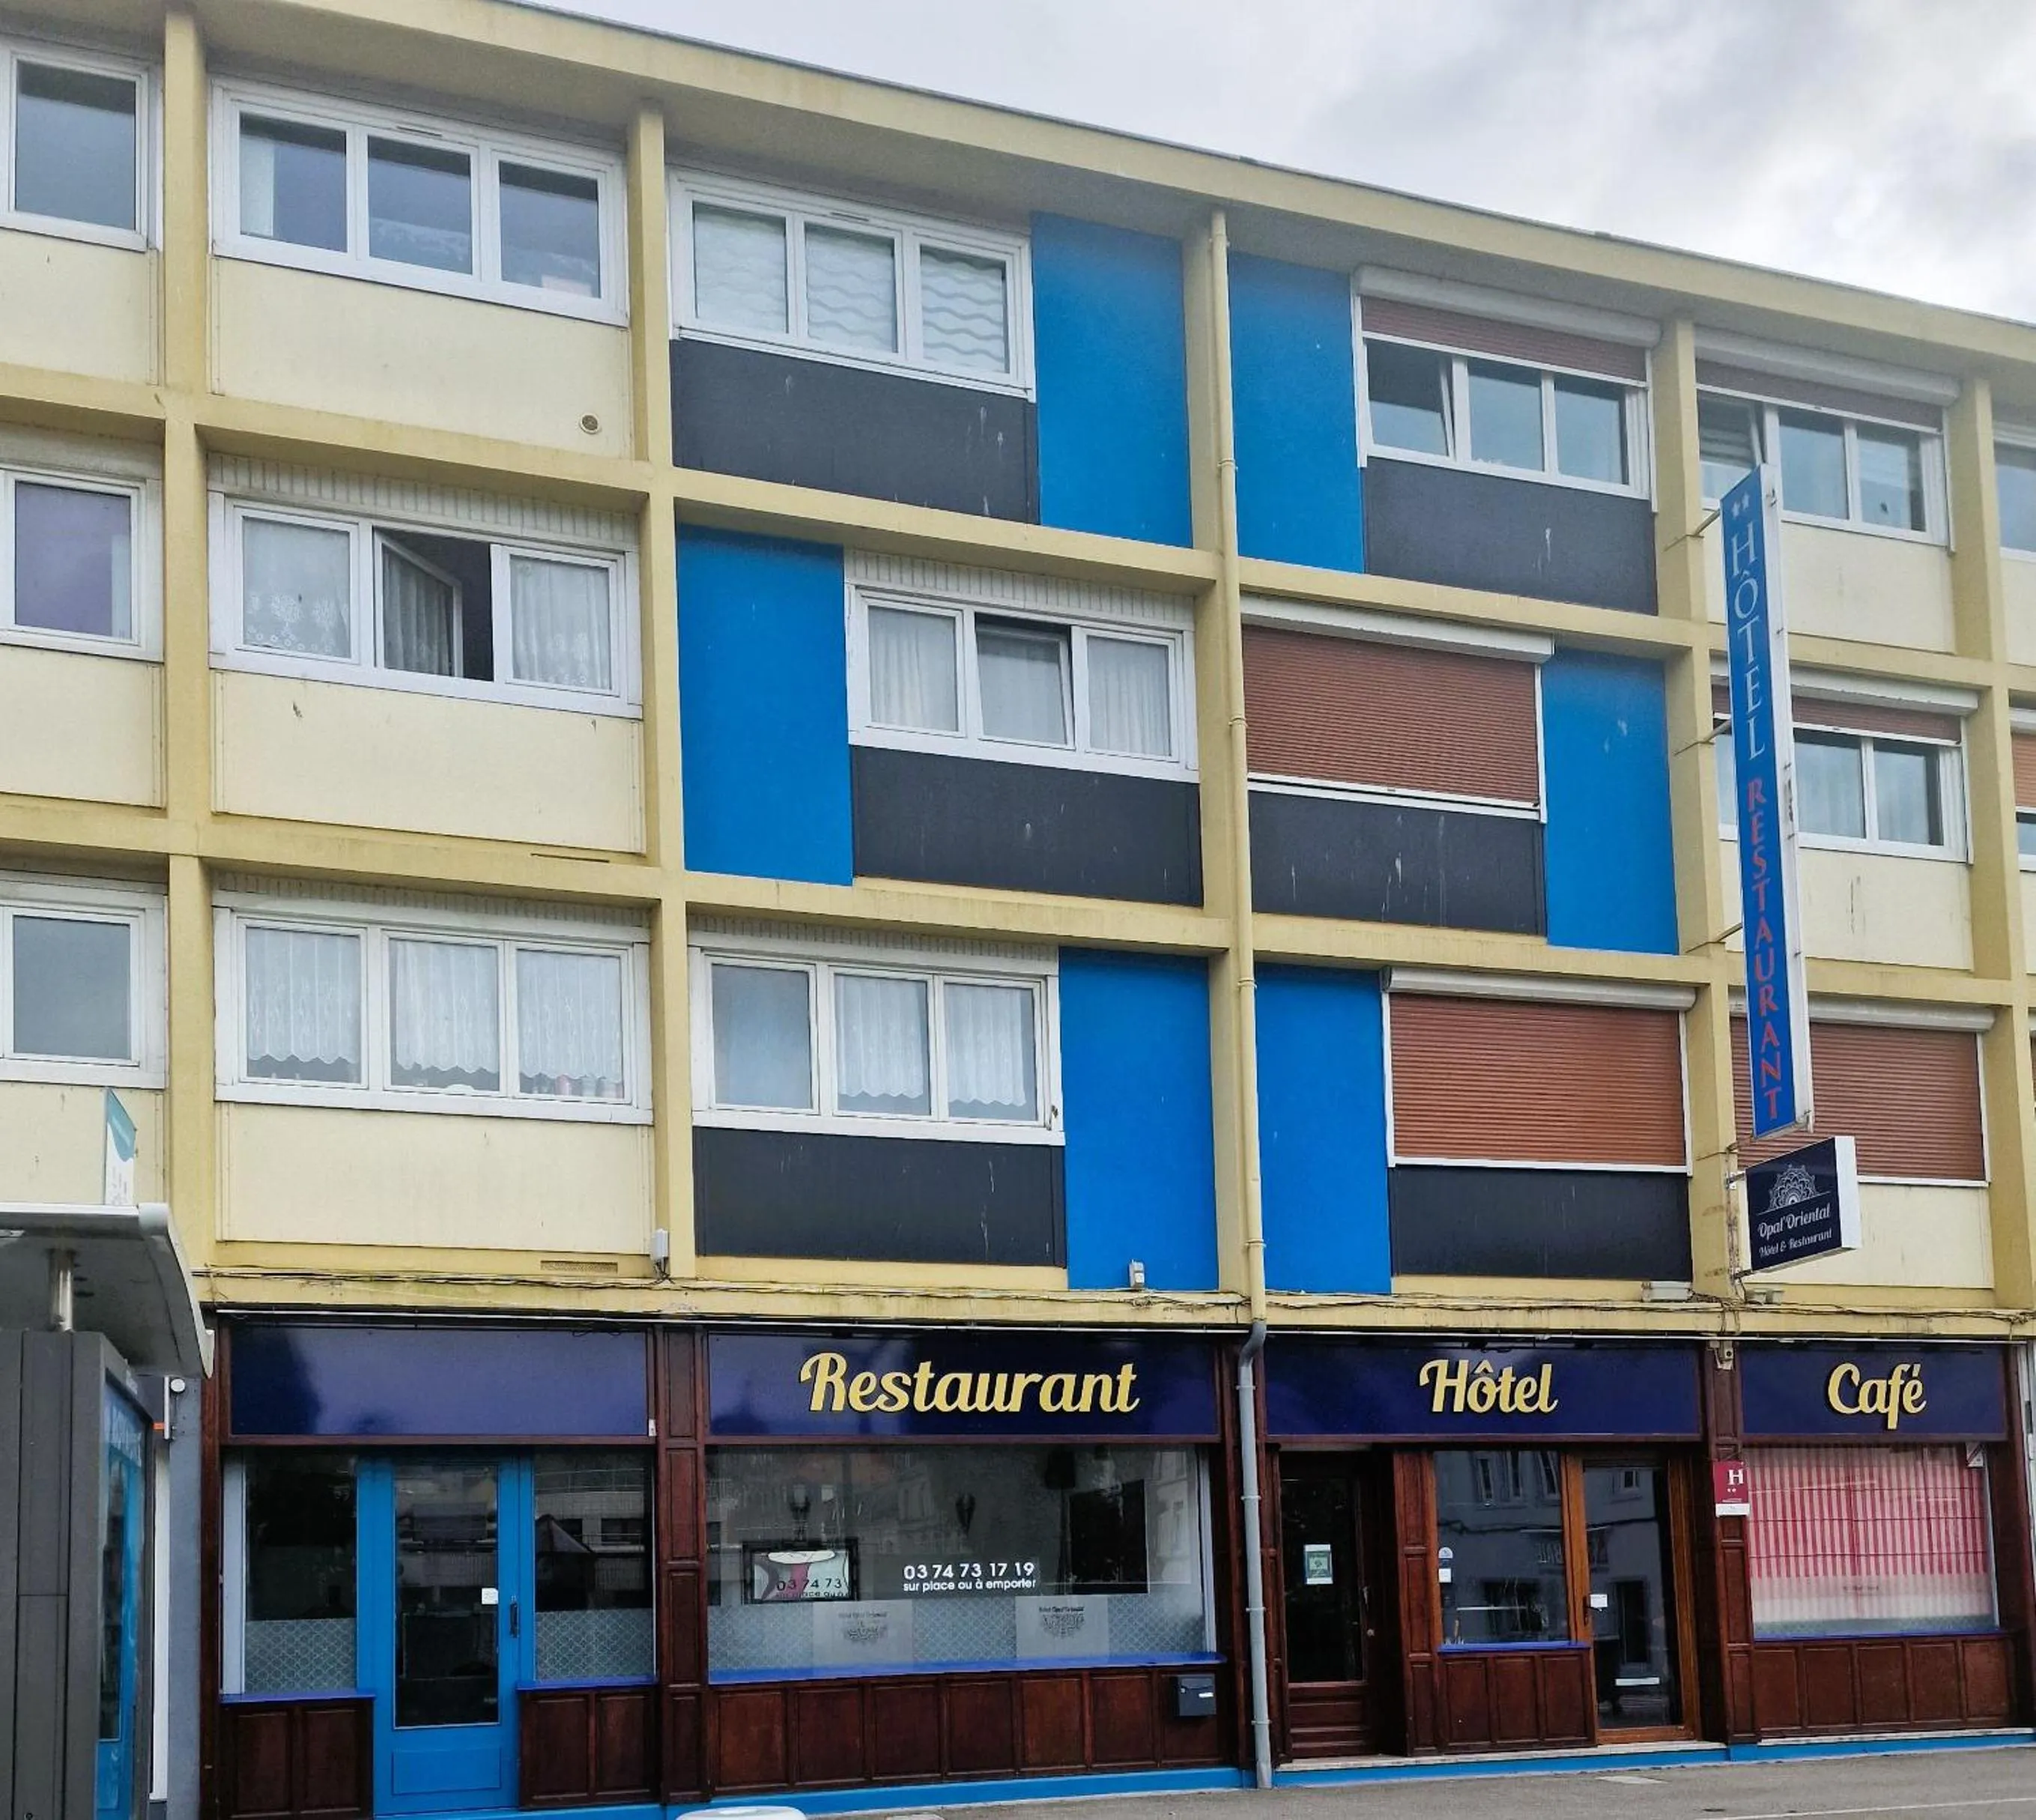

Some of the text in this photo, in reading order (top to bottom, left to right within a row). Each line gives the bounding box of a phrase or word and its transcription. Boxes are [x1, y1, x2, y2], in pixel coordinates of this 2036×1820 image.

[1732, 521, 1782, 1120] HÔTEL RESTAURANT
[799, 1351, 1139, 1413] Restaurant
[1419, 1359, 1558, 1413] Hôtel
[1828, 1362, 1927, 1430] Café
[1728, 1469, 1744, 1485] H
[903, 1562, 1035, 1580] 03 74 73 17 19
[903, 1577, 1037, 1593] sur place ou à emporter
